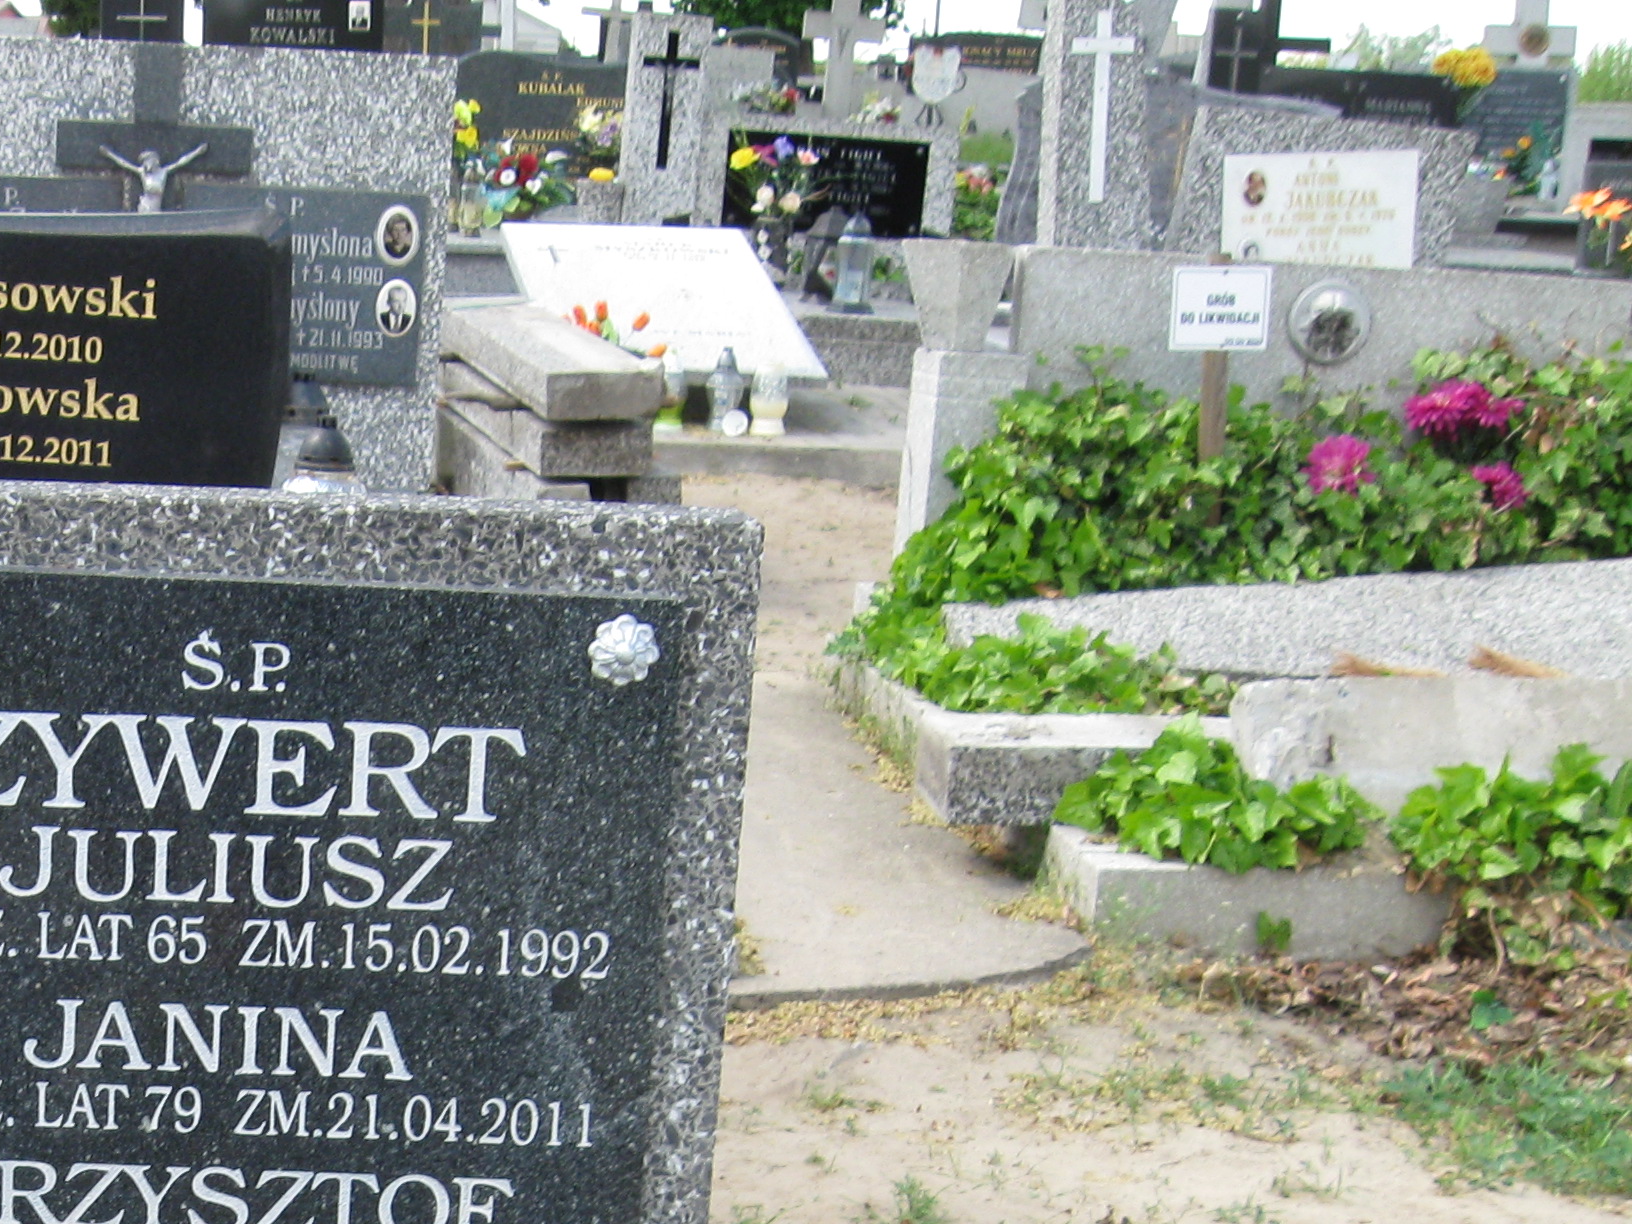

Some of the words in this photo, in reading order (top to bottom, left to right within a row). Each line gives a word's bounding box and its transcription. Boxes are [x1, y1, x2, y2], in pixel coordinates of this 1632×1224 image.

[266, 8, 321, 23] HENRYK
[250, 26, 335, 45] KOWALSKI
[518, 81, 586, 96] KUBALAK
[1206, 291, 1237, 307] GRÓB
[1180, 312, 1195, 325] DO
[1199, 311, 1261, 325] LIKWIDACJI
[37, 912, 135, 962] LAT
[146, 914, 207, 967] 65
[22, 998, 415, 1083] JANINA
[34, 1085, 135, 1132] LAT
[144, 1085, 203, 1134] 79
